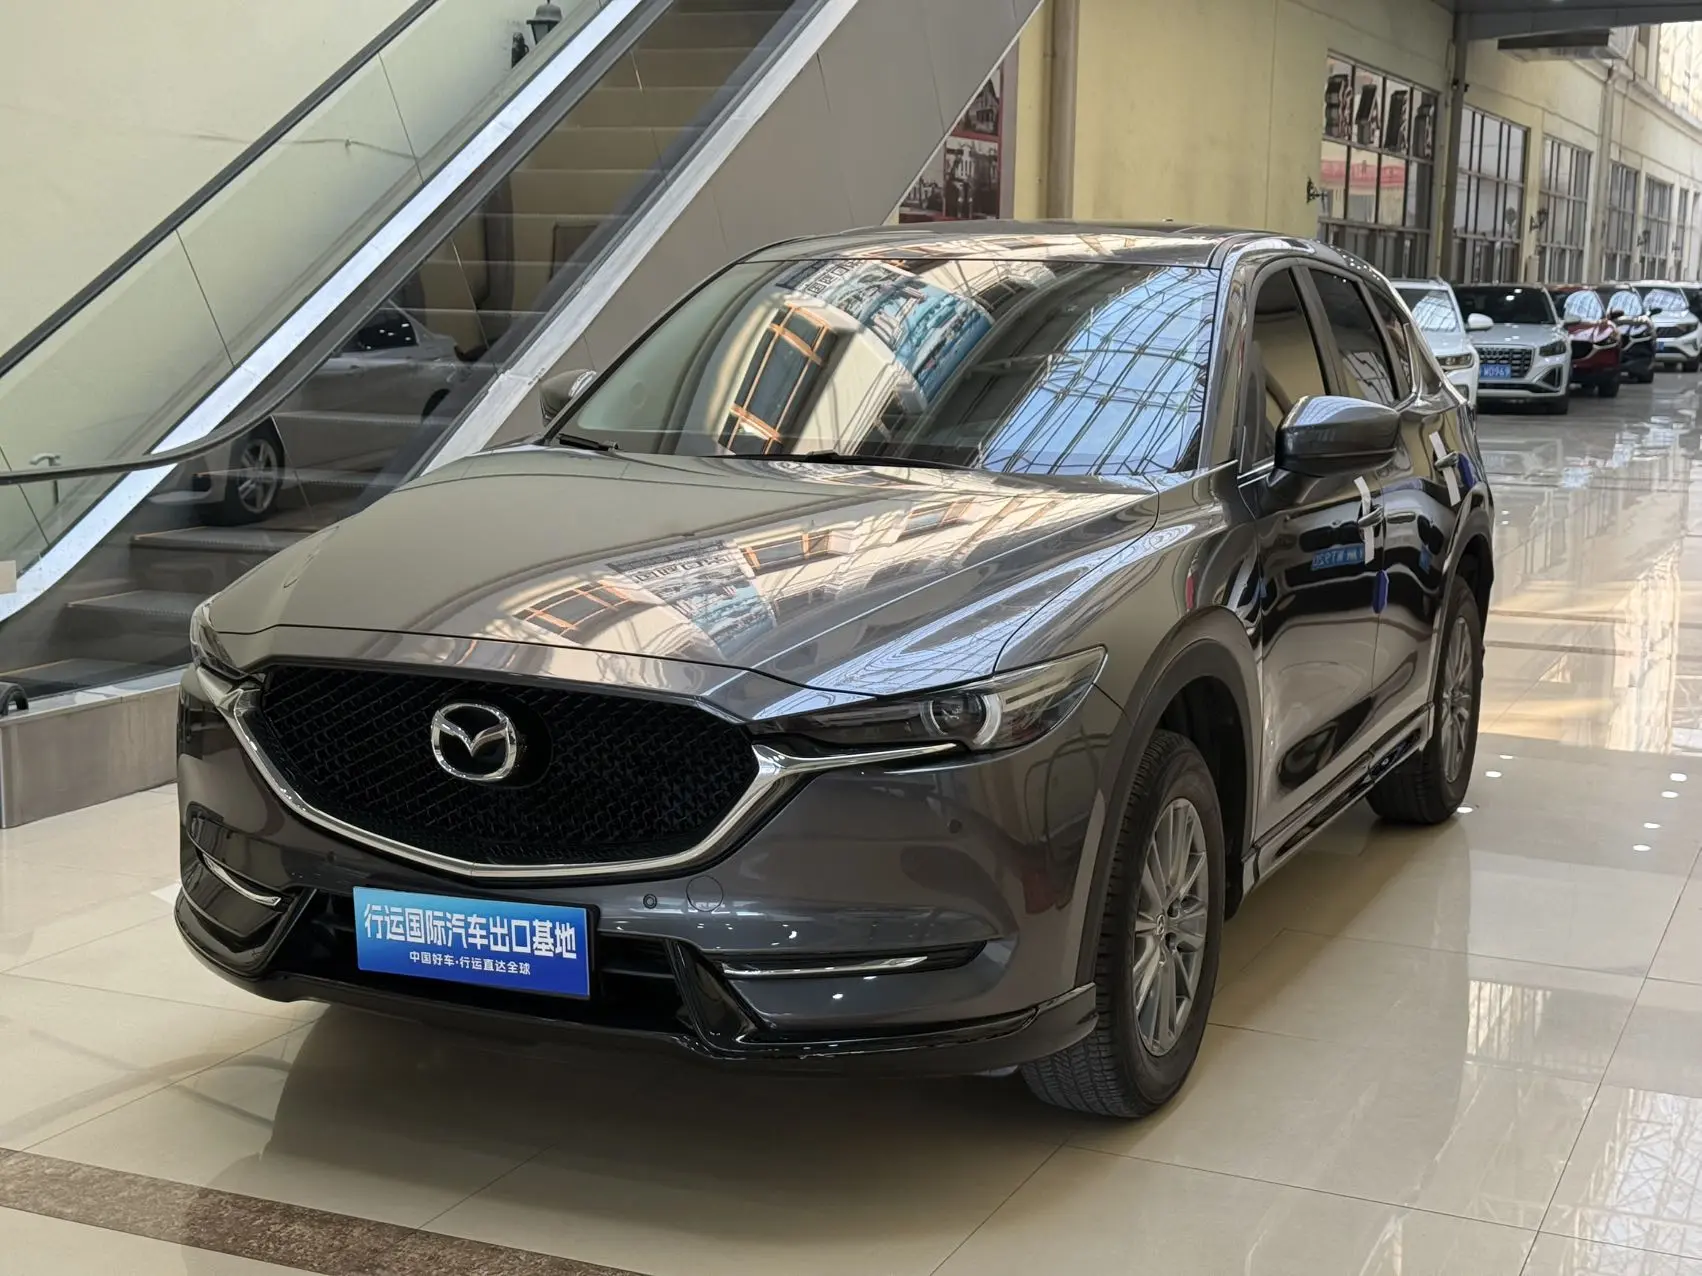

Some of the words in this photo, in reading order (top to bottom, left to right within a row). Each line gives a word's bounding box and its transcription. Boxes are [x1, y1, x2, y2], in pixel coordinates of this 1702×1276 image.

[363, 903, 577, 960] 行运国际汽车出口基地
[409, 950, 531, 976] 中国好车·行运直达全球
